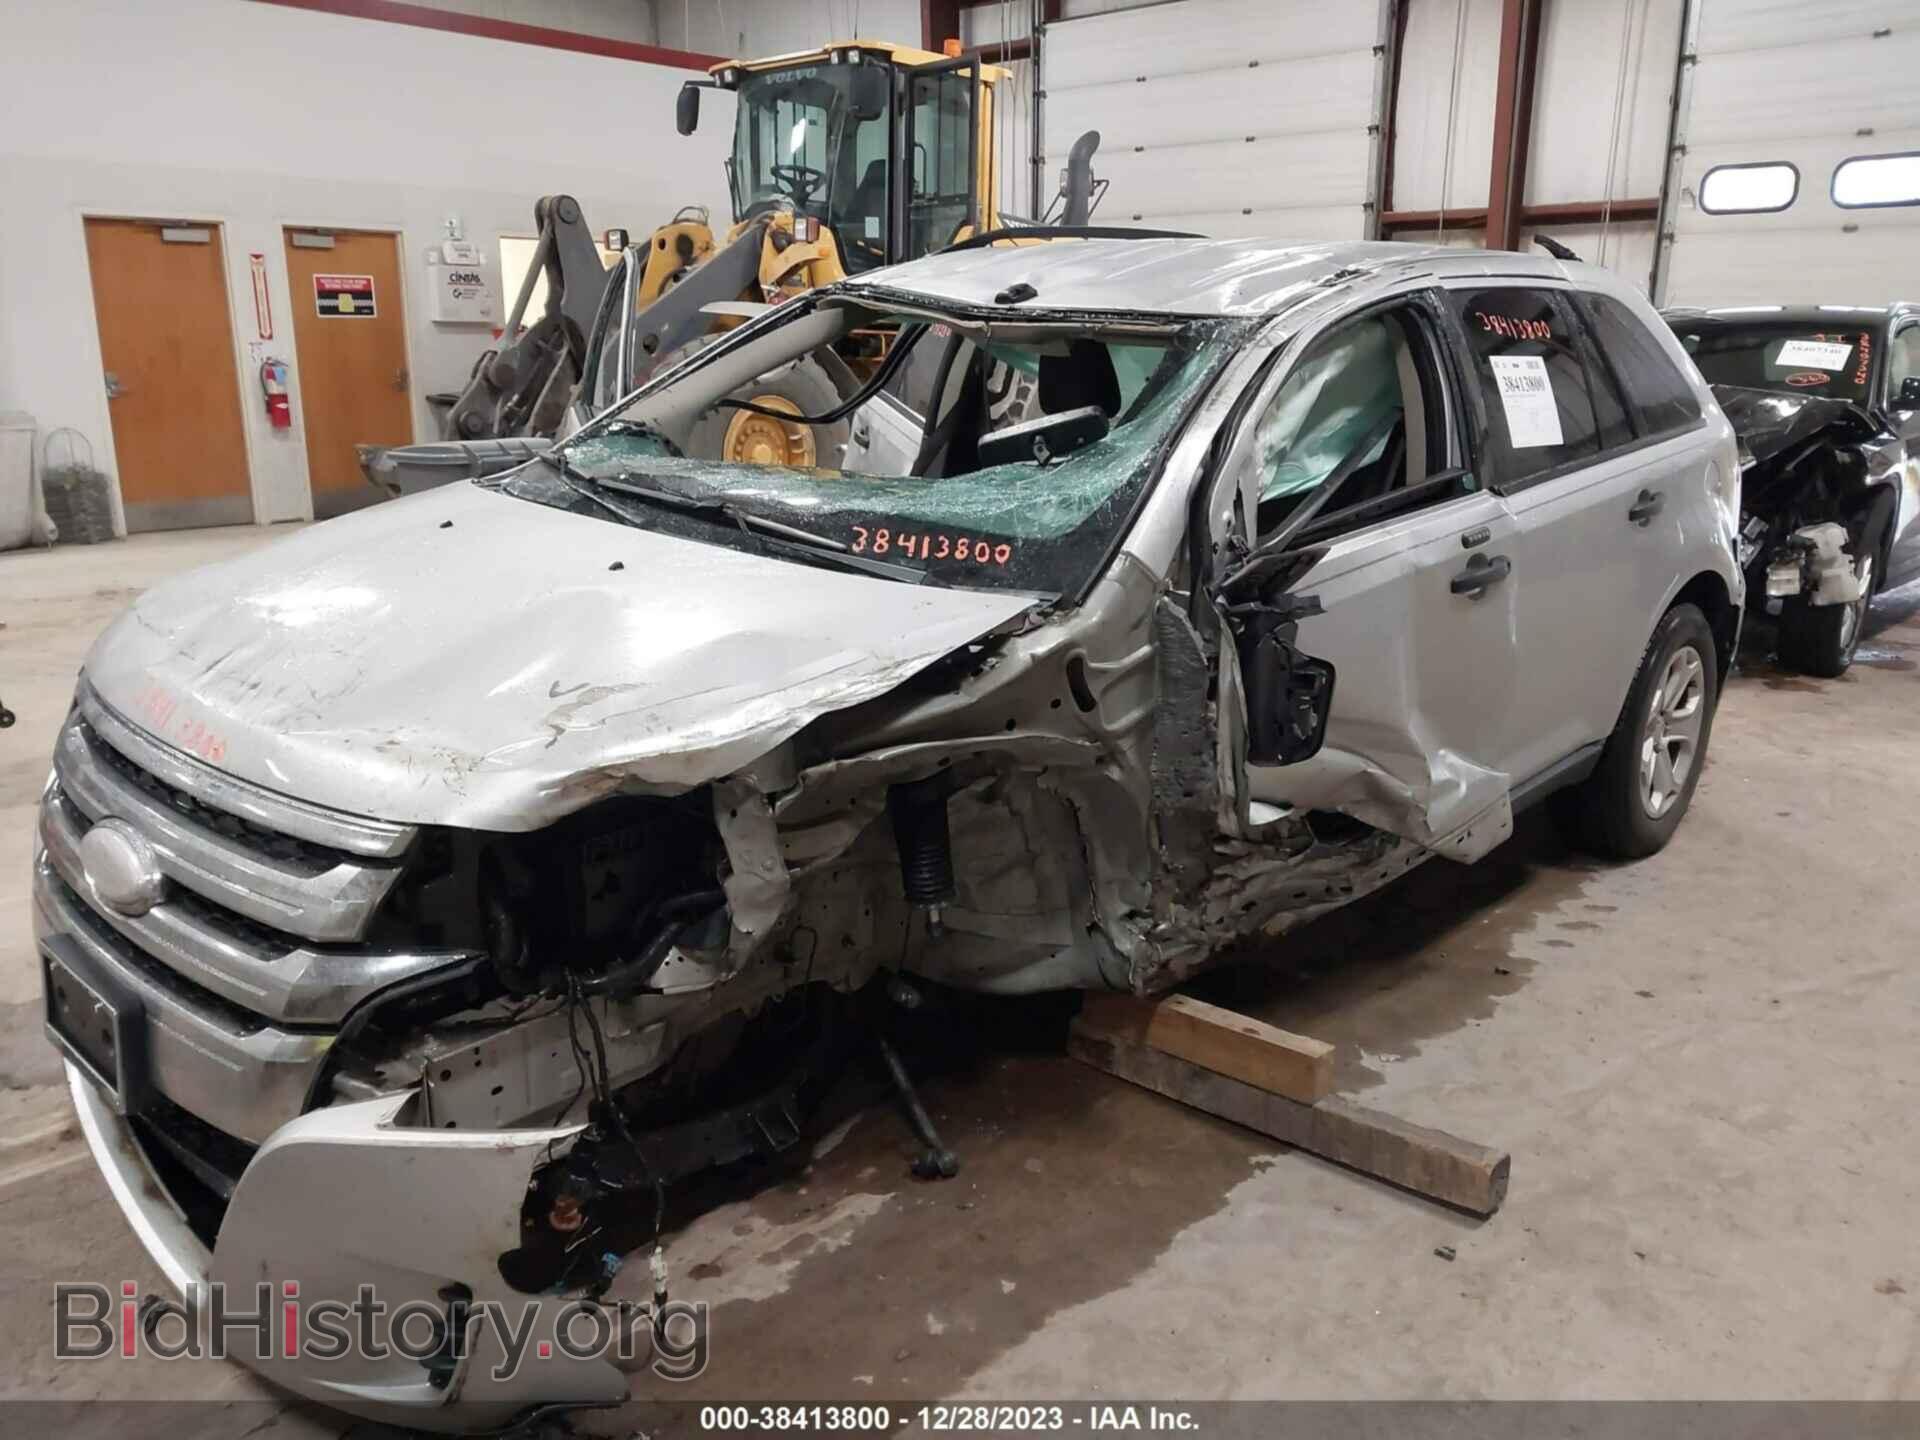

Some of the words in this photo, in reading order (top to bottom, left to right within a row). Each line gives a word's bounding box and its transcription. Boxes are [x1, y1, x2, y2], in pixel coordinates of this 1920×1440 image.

[766, 68, 817, 85] VOLVO
[1475, 312, 1552, 340] 38413800
[852, 526, 1011, 564] 38413800
